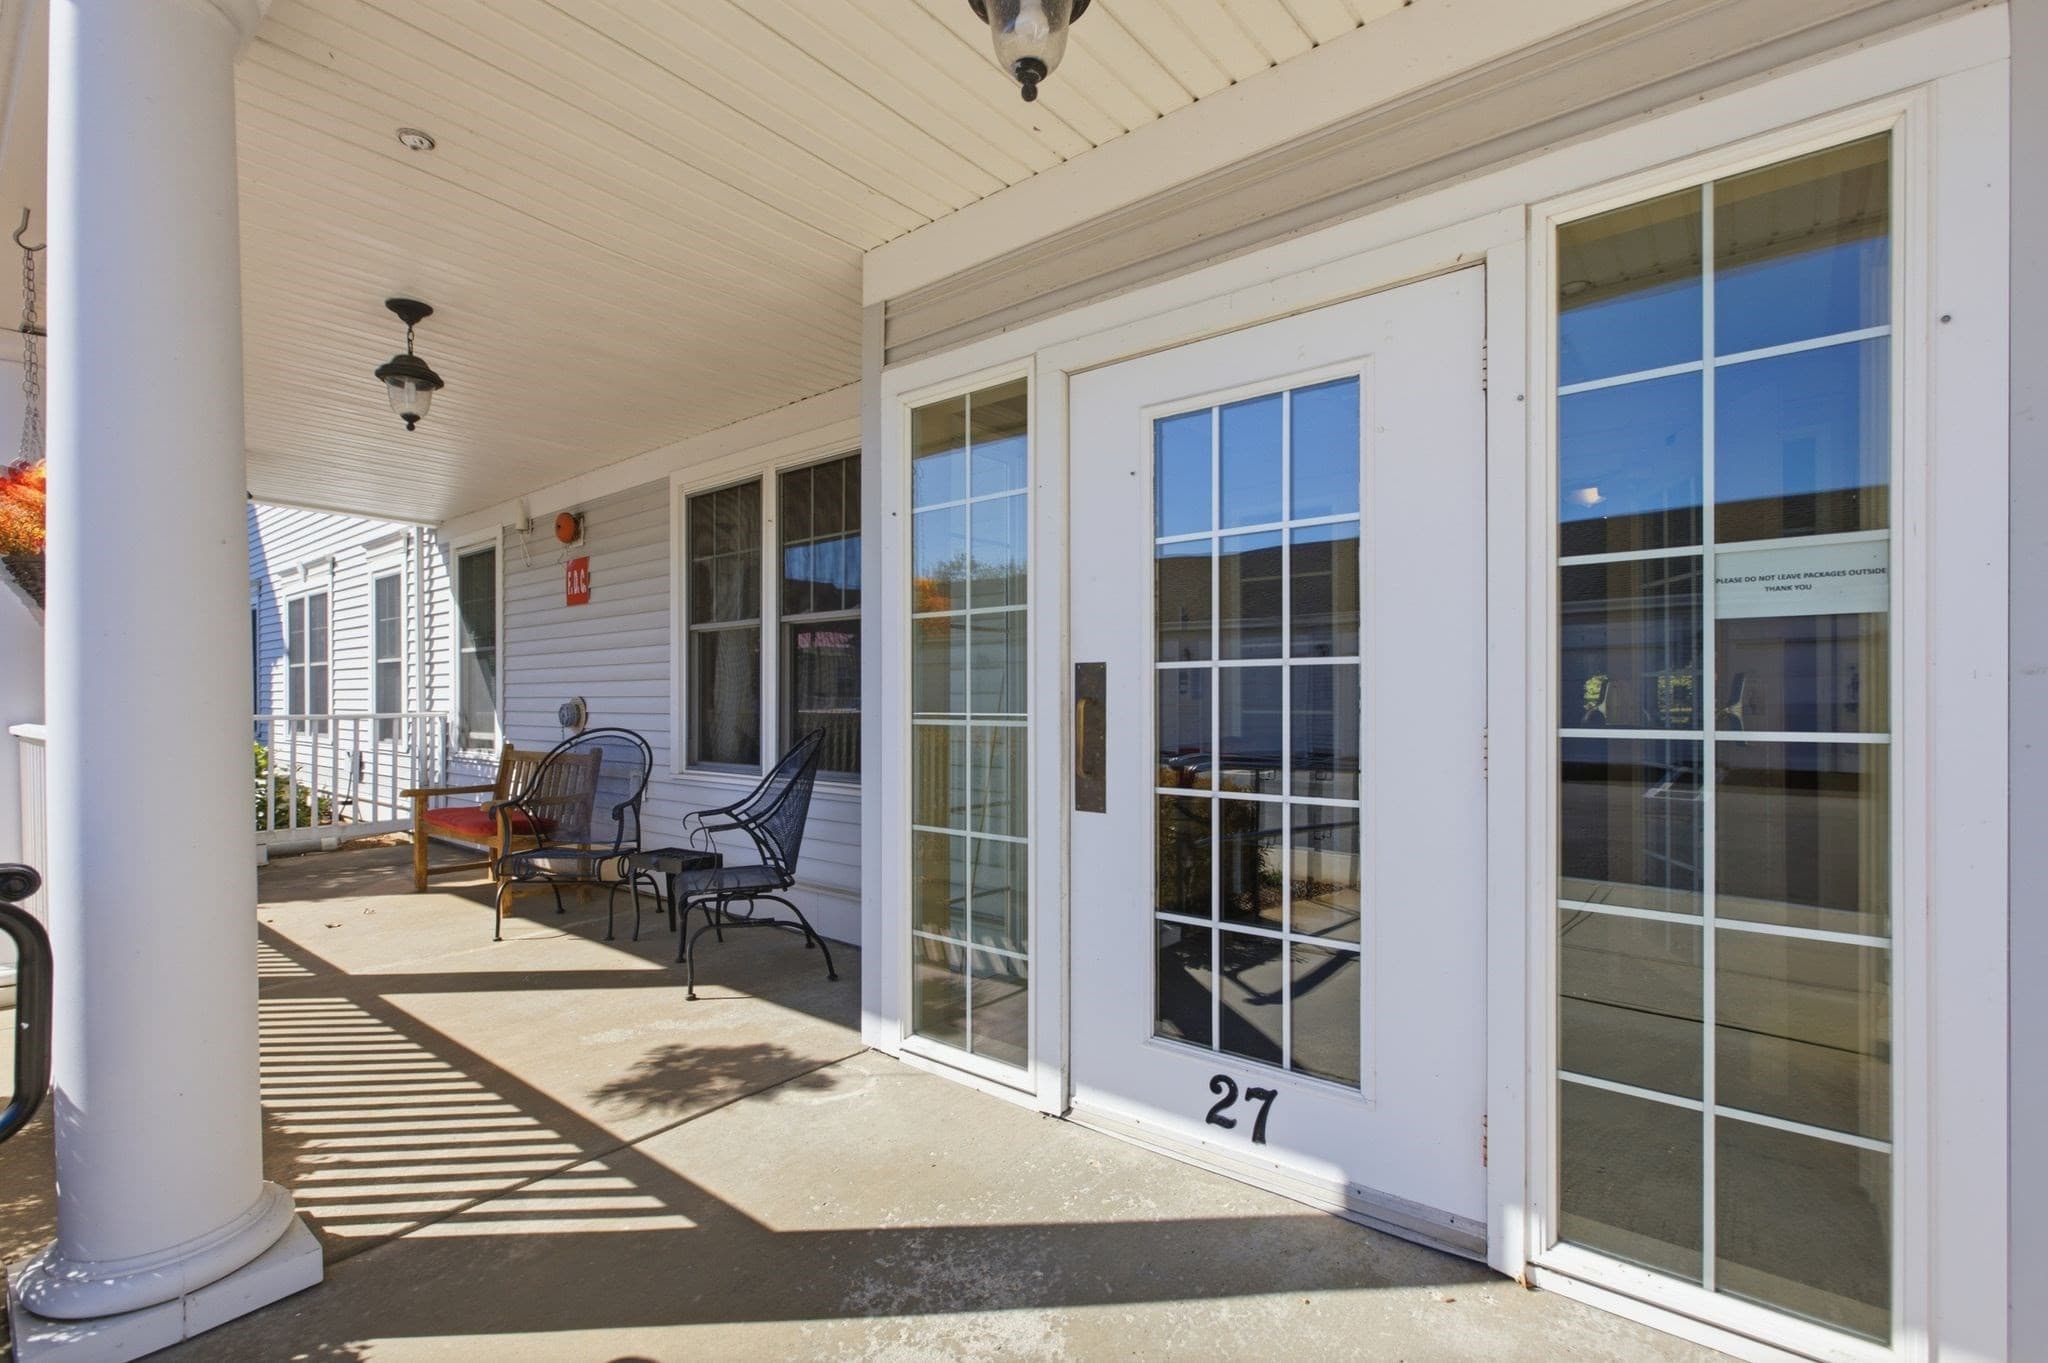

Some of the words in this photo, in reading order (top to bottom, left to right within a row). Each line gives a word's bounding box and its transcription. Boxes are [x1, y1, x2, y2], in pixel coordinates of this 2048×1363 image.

[1715, 576, 1742, 584] PLEASE
[1759, 574, 1775, 582] NOT
[1777, 573, 1801, 581] LEAVE
[1803, 570, 1847, 579] PACKAGES
[1848, 567, 1887, 576] OUTSIDE
[1793, 583, 1812, 591] YOU
[1205, 1074, 1278, 1145] 27
